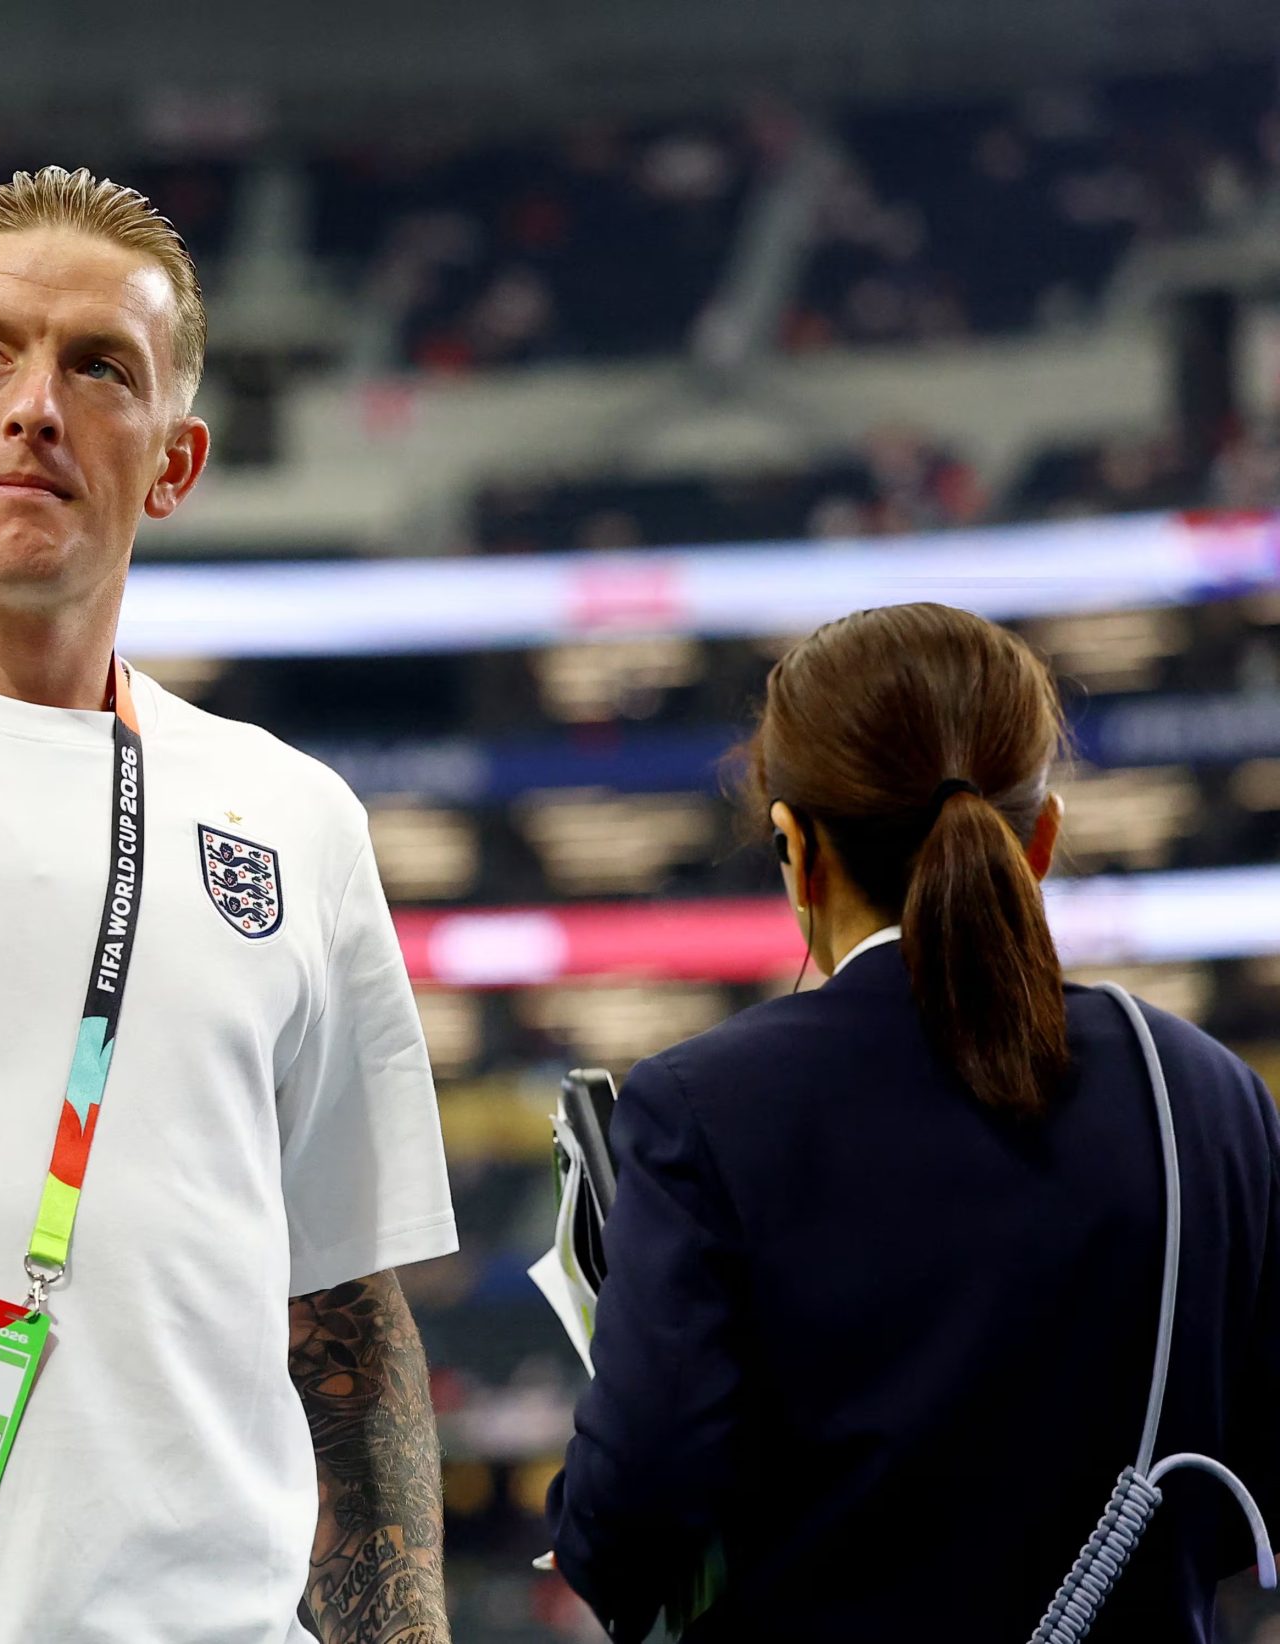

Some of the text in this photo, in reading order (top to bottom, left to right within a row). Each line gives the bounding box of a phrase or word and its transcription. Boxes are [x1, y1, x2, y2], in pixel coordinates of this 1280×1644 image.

[96, 746, 138, 993] FIFA WORLD CUP 2026
